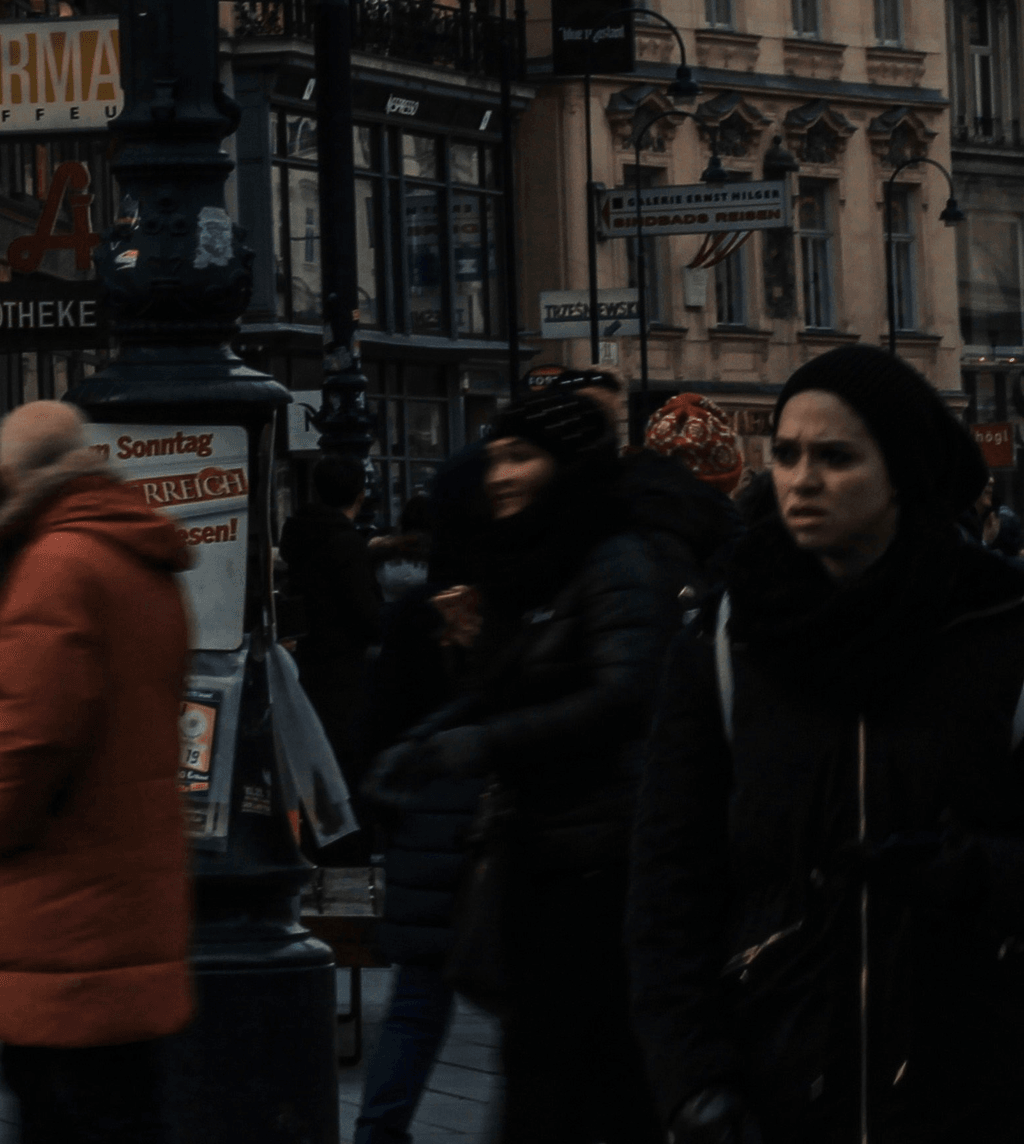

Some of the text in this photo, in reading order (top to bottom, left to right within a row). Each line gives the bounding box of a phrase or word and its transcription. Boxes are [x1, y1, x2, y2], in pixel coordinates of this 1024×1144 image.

[686, 191, 728, 204] ERNST
[731, 188, 780, 201] HILGER
[715, 209, 781, 224] REISEN
[116, 431, 214, 460] Sonntag
